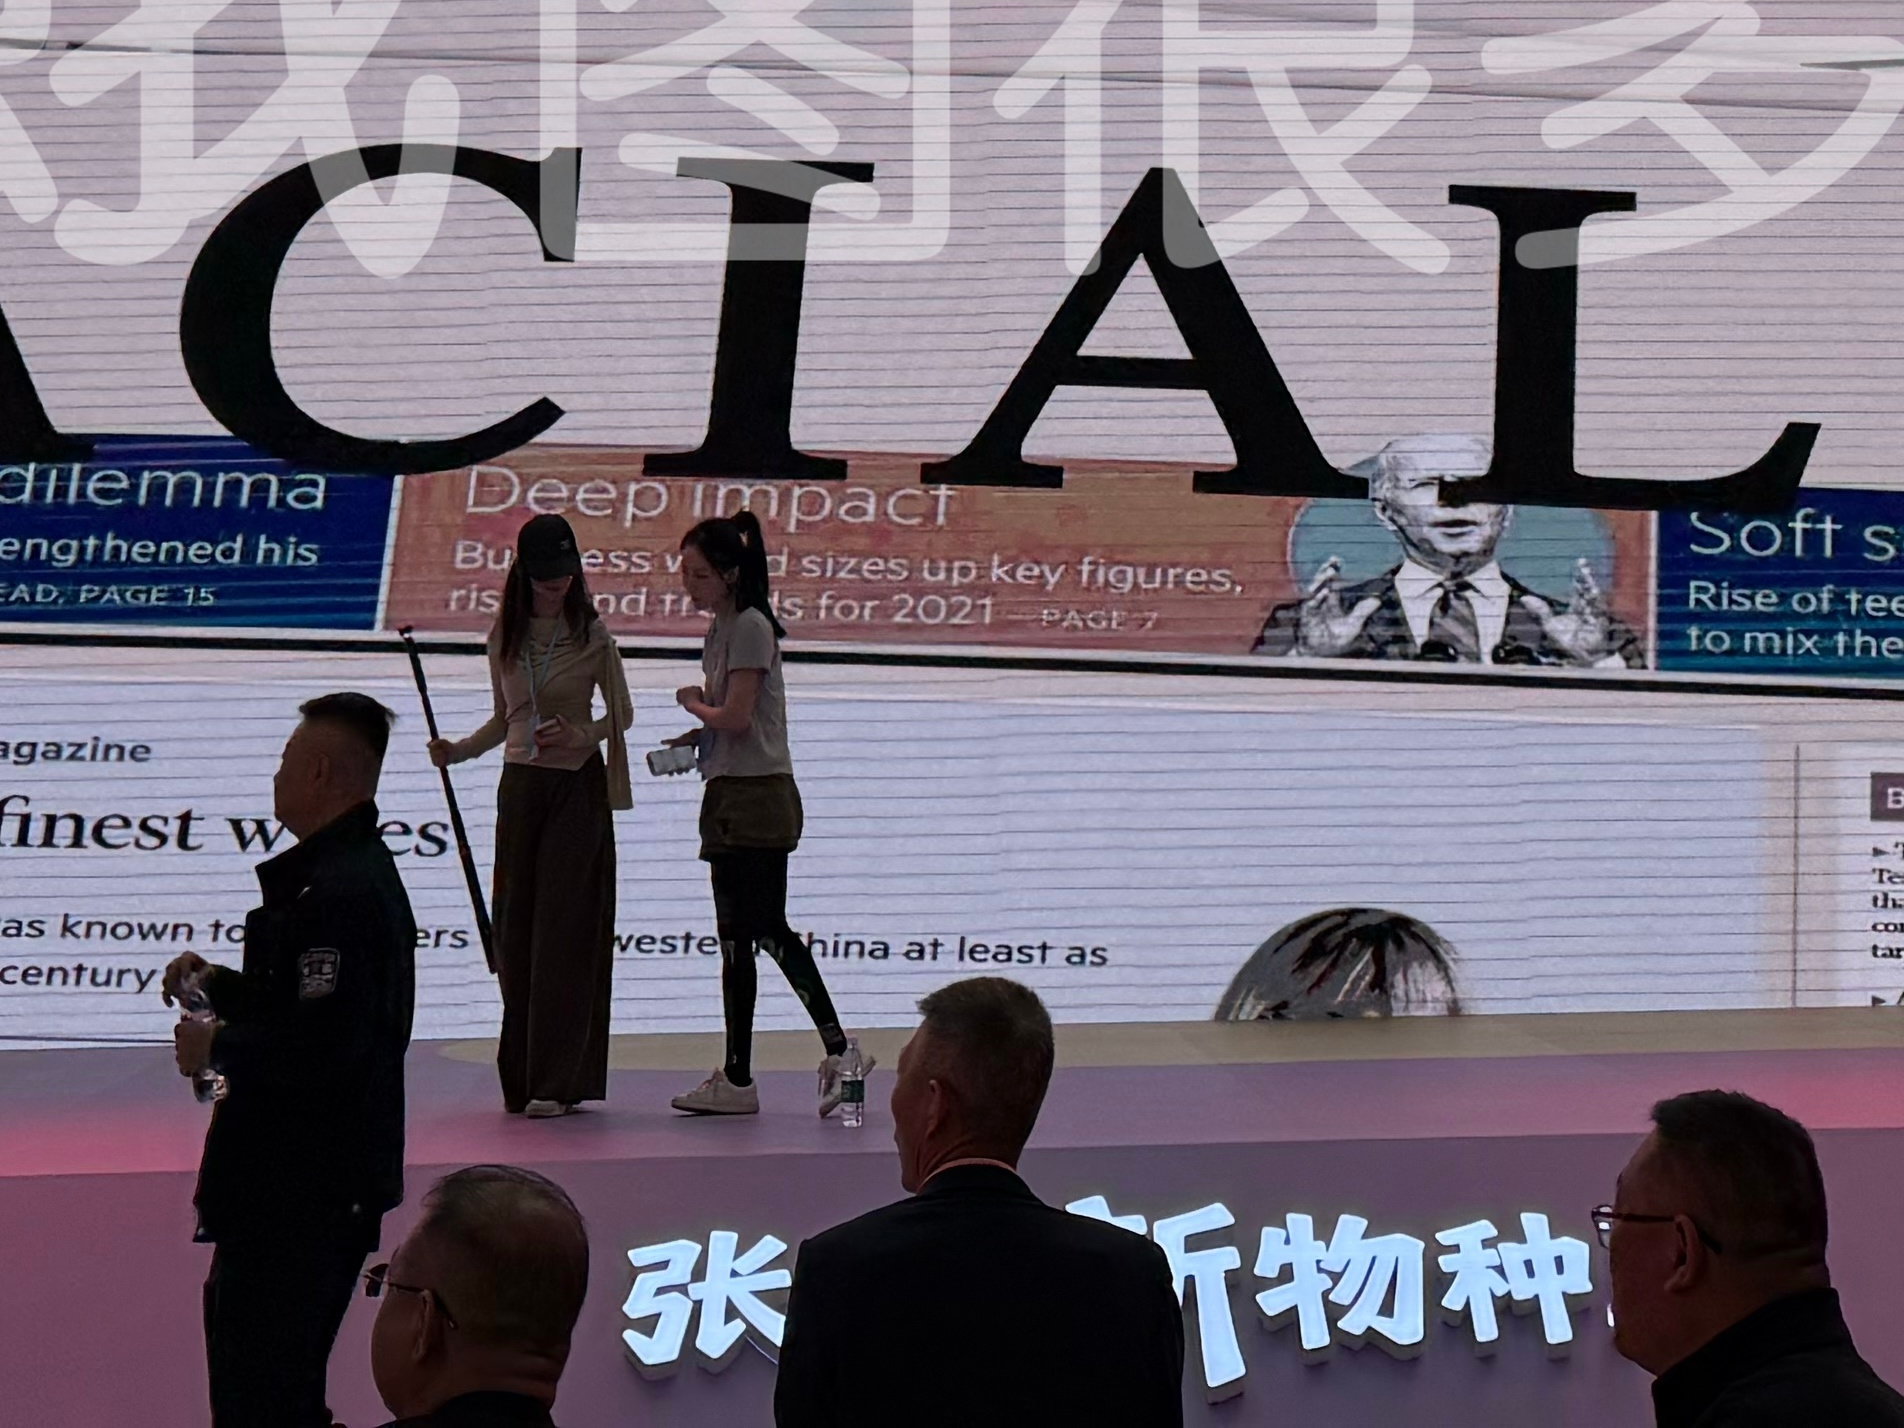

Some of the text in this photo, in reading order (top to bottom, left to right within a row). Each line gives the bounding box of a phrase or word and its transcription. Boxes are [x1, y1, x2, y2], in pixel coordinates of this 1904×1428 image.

[465, 466, 957, 532] Deep impact
[257, 534, 320, 568] his
[1689, 506, 1842, 563] Soft
[455, 540, 652, 574] Buess
[801, 548, 912, 579] sizes
[922, 557, 978, 587] up
[991, 553, 1068, 591] key
[1079, 555, 1244, 596] figures,
[79, 584, 170, 606] PAGE
[183, 587, 218, 607] 15
[595, 587, 1159, 631] nd for 2021 PAGE 7
[1687, 580, 1779, 613] Rise
[1791, 585, 1836, 616] of
[1687, 625, 1732, 655] to
[1744, 625, 1819, 658] mix
[226, 809, 452, 858] wes
[60, 912, 195, 945] known
[209, 918, 246, 947] to
[798, 931, 890, 961] hina
[903, 938, 947, 963] at
[957, 936, 1050, 966] least
[1064, 945, 1109, 968] as
